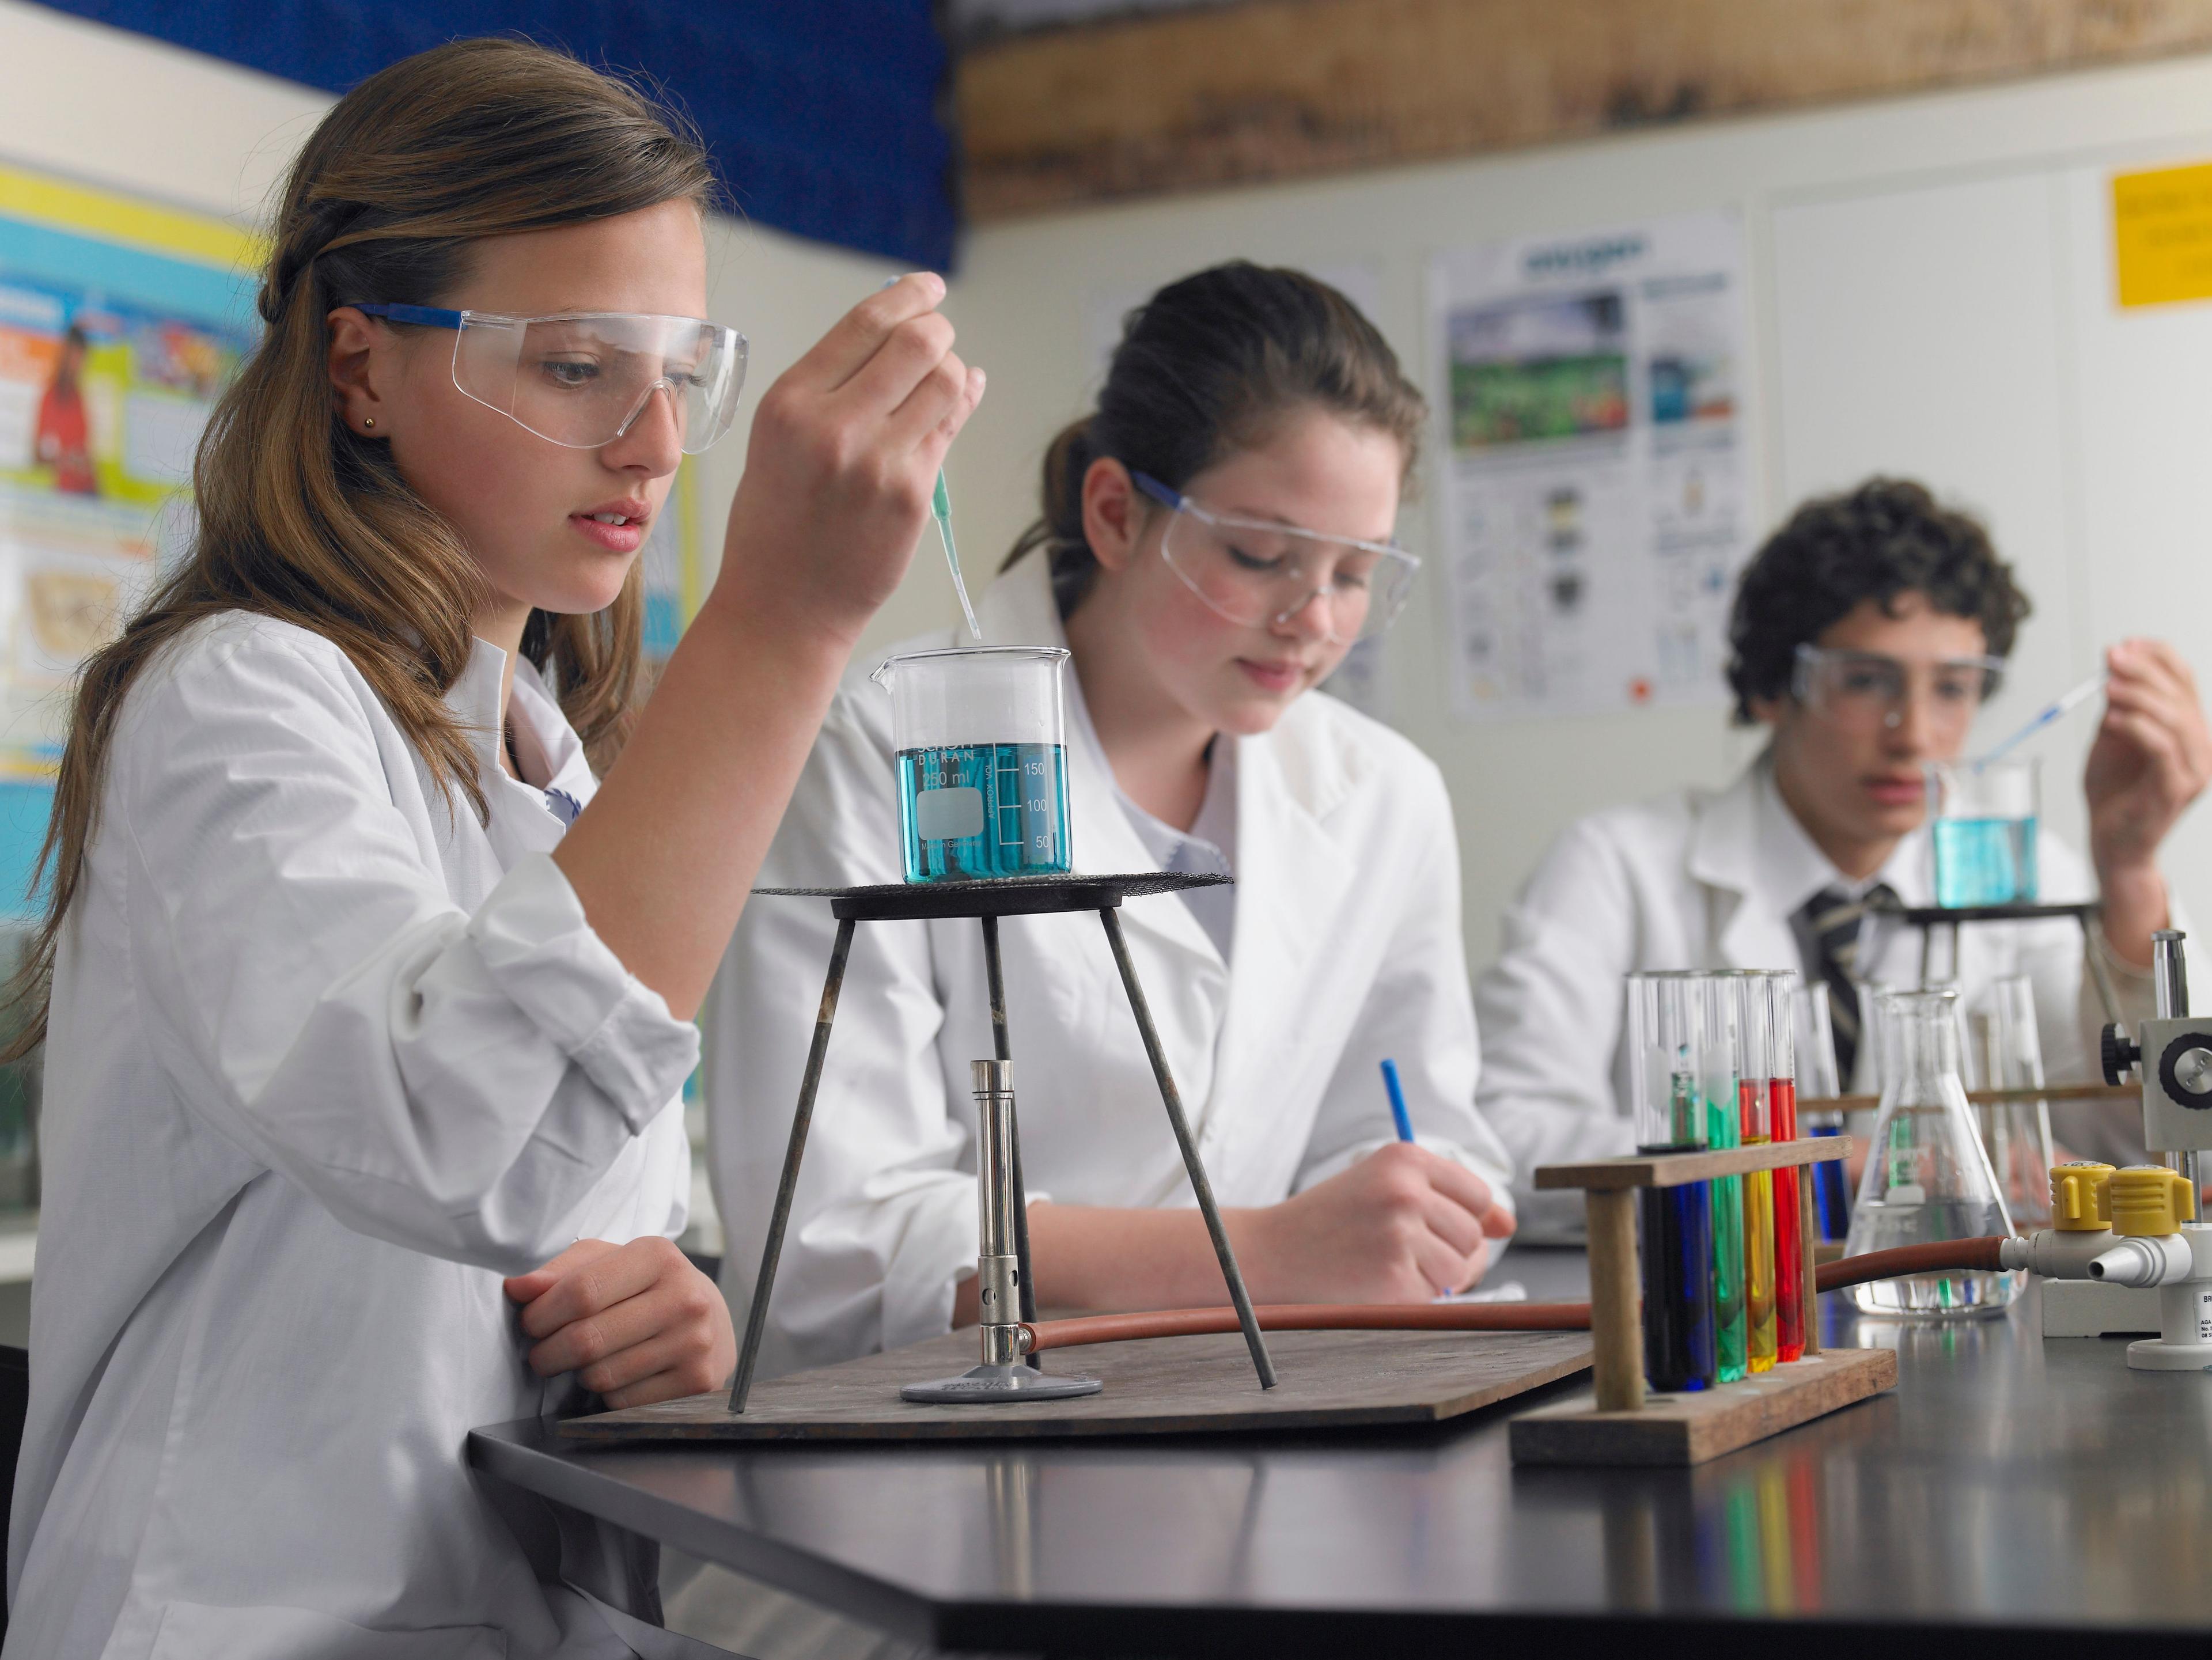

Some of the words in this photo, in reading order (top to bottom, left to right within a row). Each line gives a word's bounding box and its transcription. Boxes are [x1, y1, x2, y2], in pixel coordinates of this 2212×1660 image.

[918, 751, 974, 765] DURAN
[1024, 763, 1044, 775] 150
[922, 771, 947, 787] 250
[952, 770, 969, 784] ml
[986, 784, 995, 818] APPROX
[1027, 799, 1047, 812] 100
[1036, 836, 1049, 848] 50
